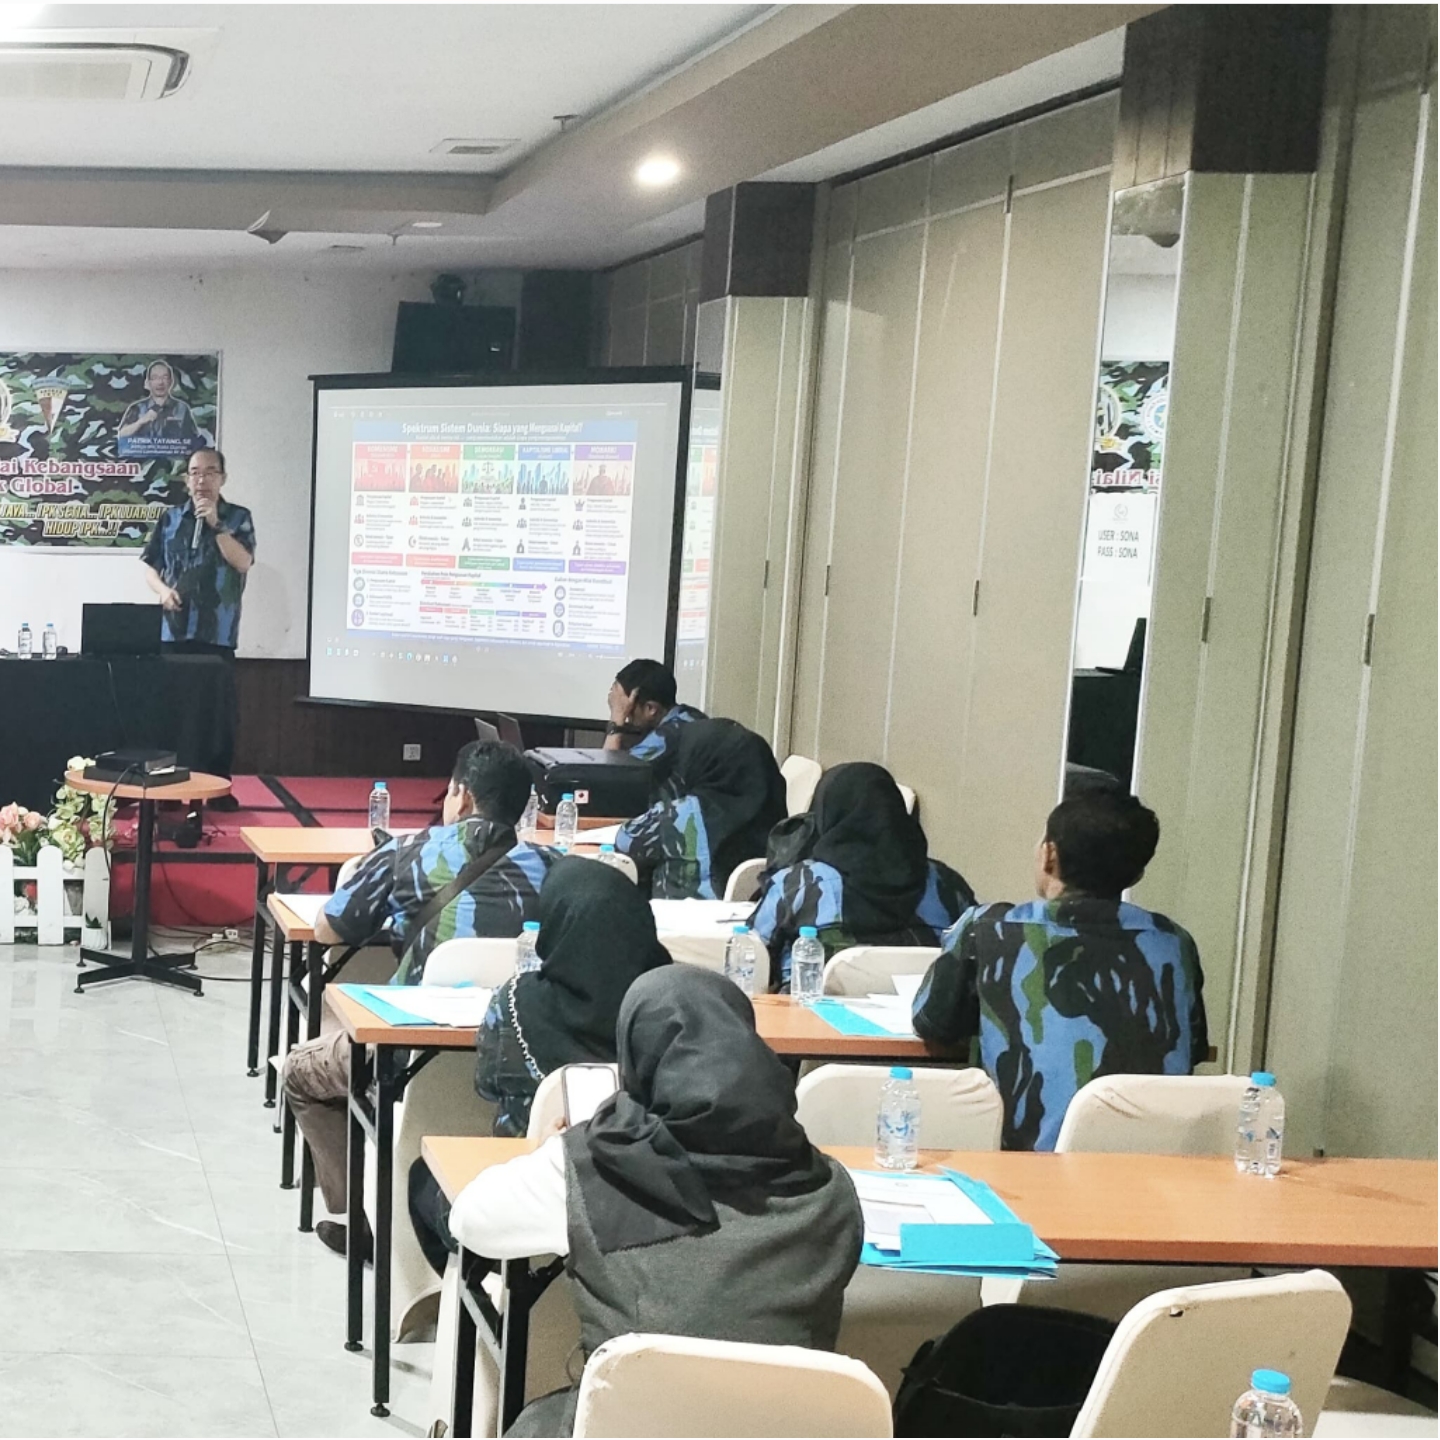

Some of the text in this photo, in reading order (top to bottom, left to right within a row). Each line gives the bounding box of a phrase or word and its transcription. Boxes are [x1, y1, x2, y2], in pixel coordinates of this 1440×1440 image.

[402, 422, 439, 436] Spektrum
[440, 422, 466, 433] Sistem
[492, 422, 512, 436] Siapa
[24, 459, 140, 477] Kebangsaan
[11, 477, 73, 493] Global
[45, 520, 79, 536] HIDUP
[1098, 529, 1115, 541] USER
[1120, 530, 1139, 542] SONA
[1097, 545, 1113, 557] PASS
[1118, 546, 1138, 558] SONA
